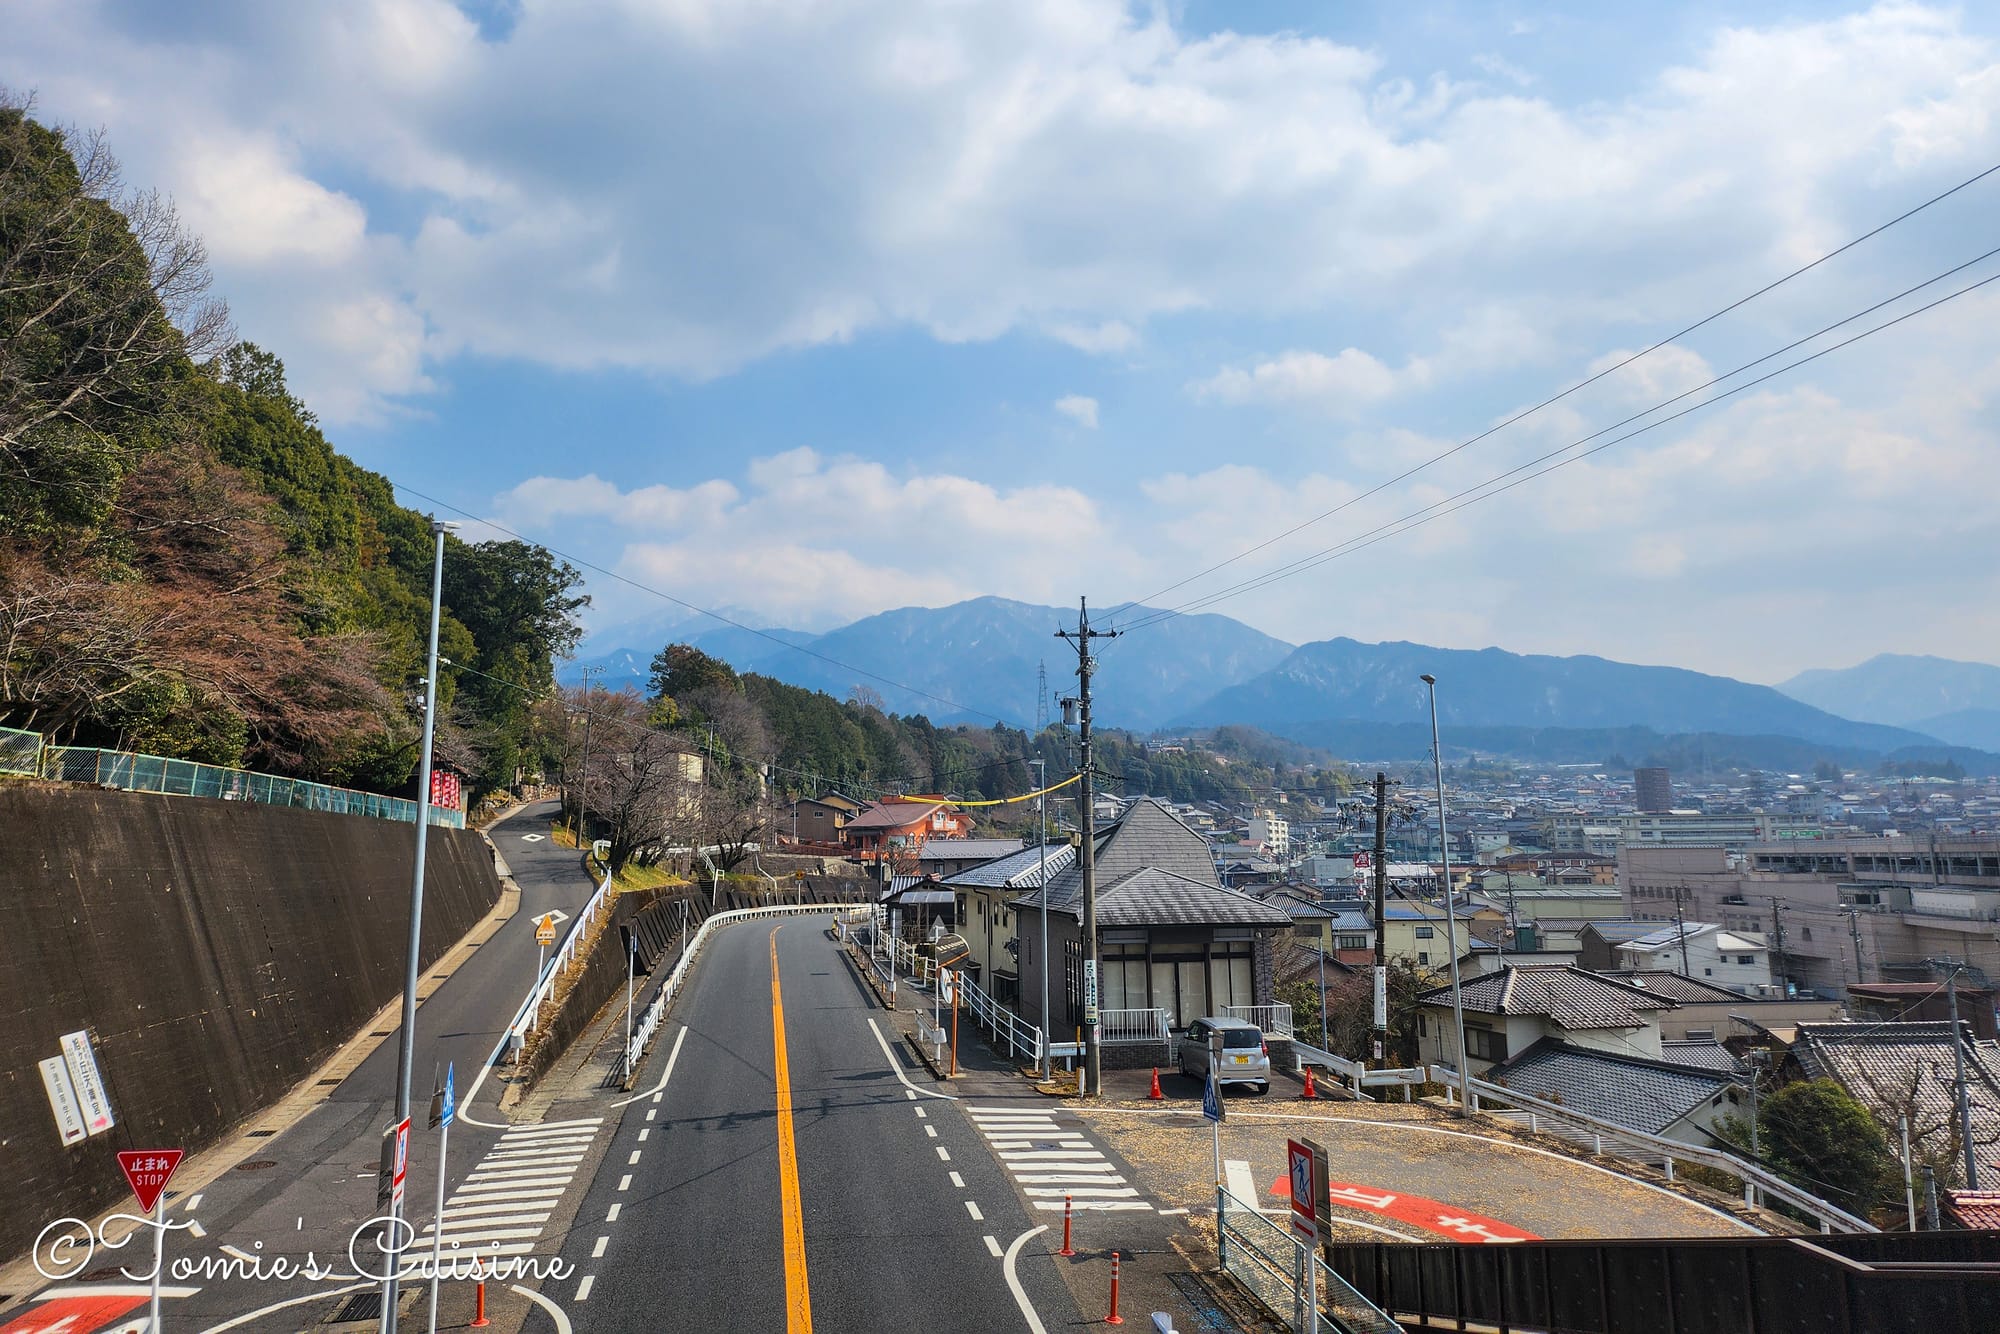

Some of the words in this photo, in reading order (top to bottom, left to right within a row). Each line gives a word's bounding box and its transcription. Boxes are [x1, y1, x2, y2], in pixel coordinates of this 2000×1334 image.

[130, 1157, 169, 1171] 止まれ
[136, 1175, 163, 1186] STOP
